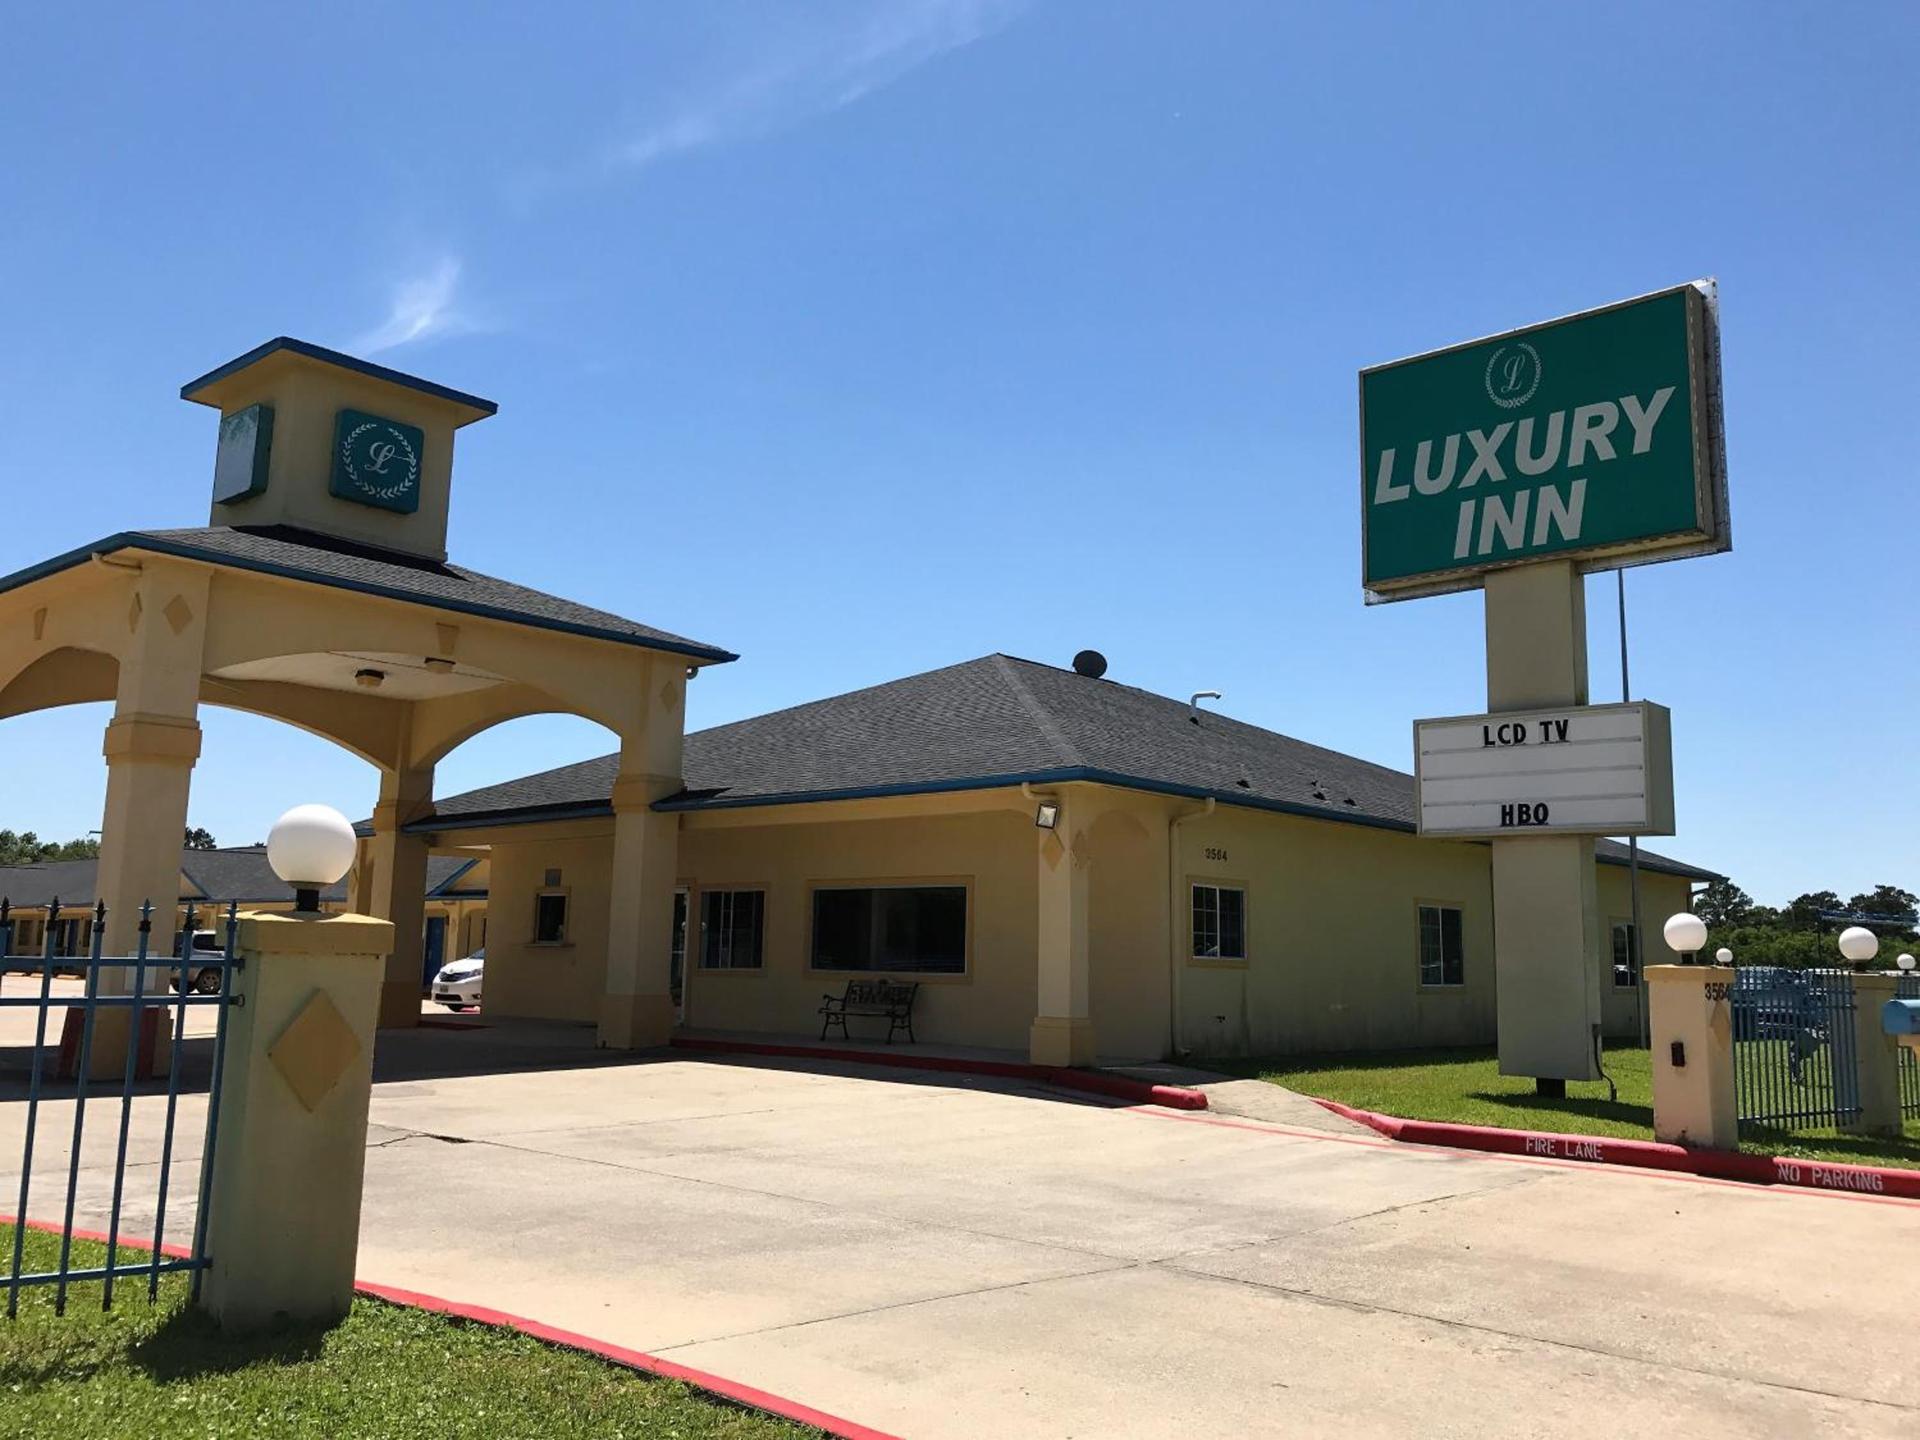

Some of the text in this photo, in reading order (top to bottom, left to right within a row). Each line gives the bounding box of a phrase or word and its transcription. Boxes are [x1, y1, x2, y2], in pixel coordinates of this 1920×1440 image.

[1374, 386, 1677, 505] LUXURY
[1453, 478, 1588, 560] INN
[1483, 719, 1569, 747] LCD TV
[1500, 802, 1549, 826] HBO
[1526, 1136, 1603, 1160] FIRE LANE
[1778, 1163, 1884, 1191] NO PARKING
